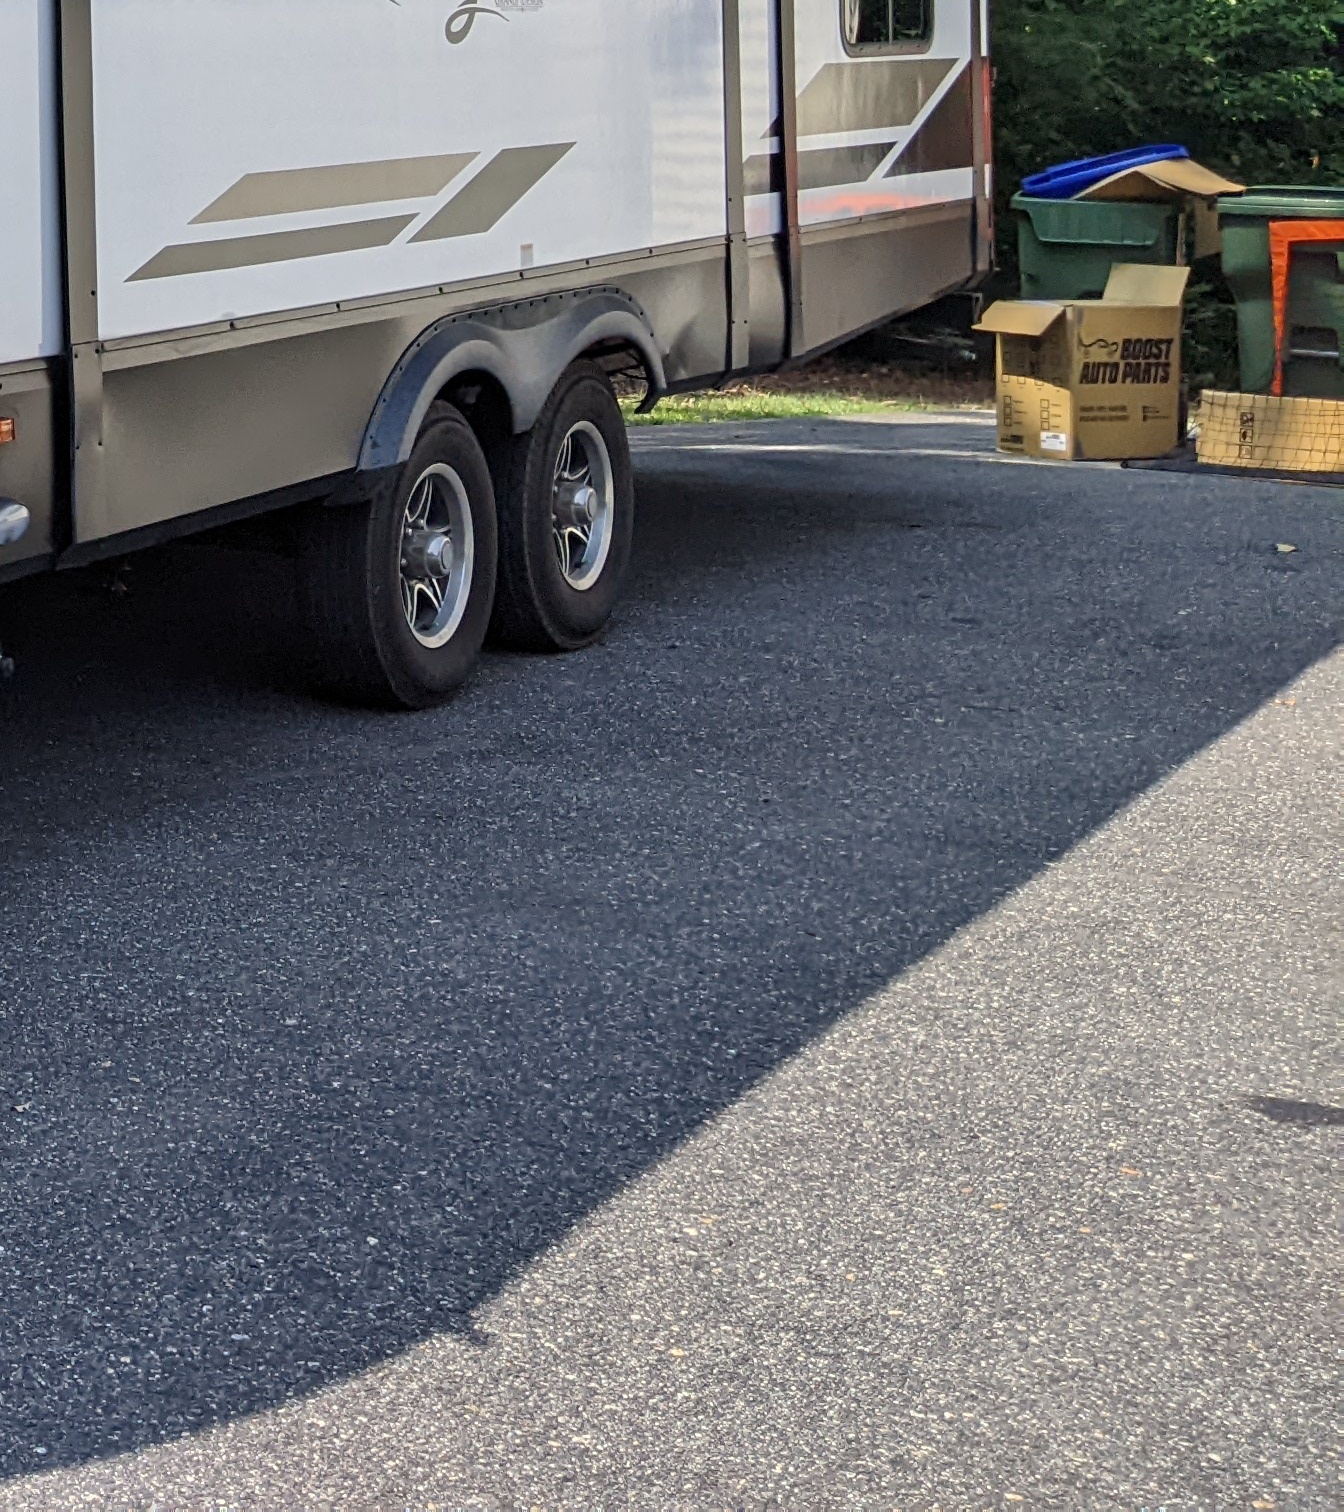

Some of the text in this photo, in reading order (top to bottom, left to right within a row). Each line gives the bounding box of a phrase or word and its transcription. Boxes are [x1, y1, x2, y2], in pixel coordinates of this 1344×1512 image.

[1119, 338, 1174, 361] BOOST
[1079, 361, 1171, 384] AUTO PARTS
